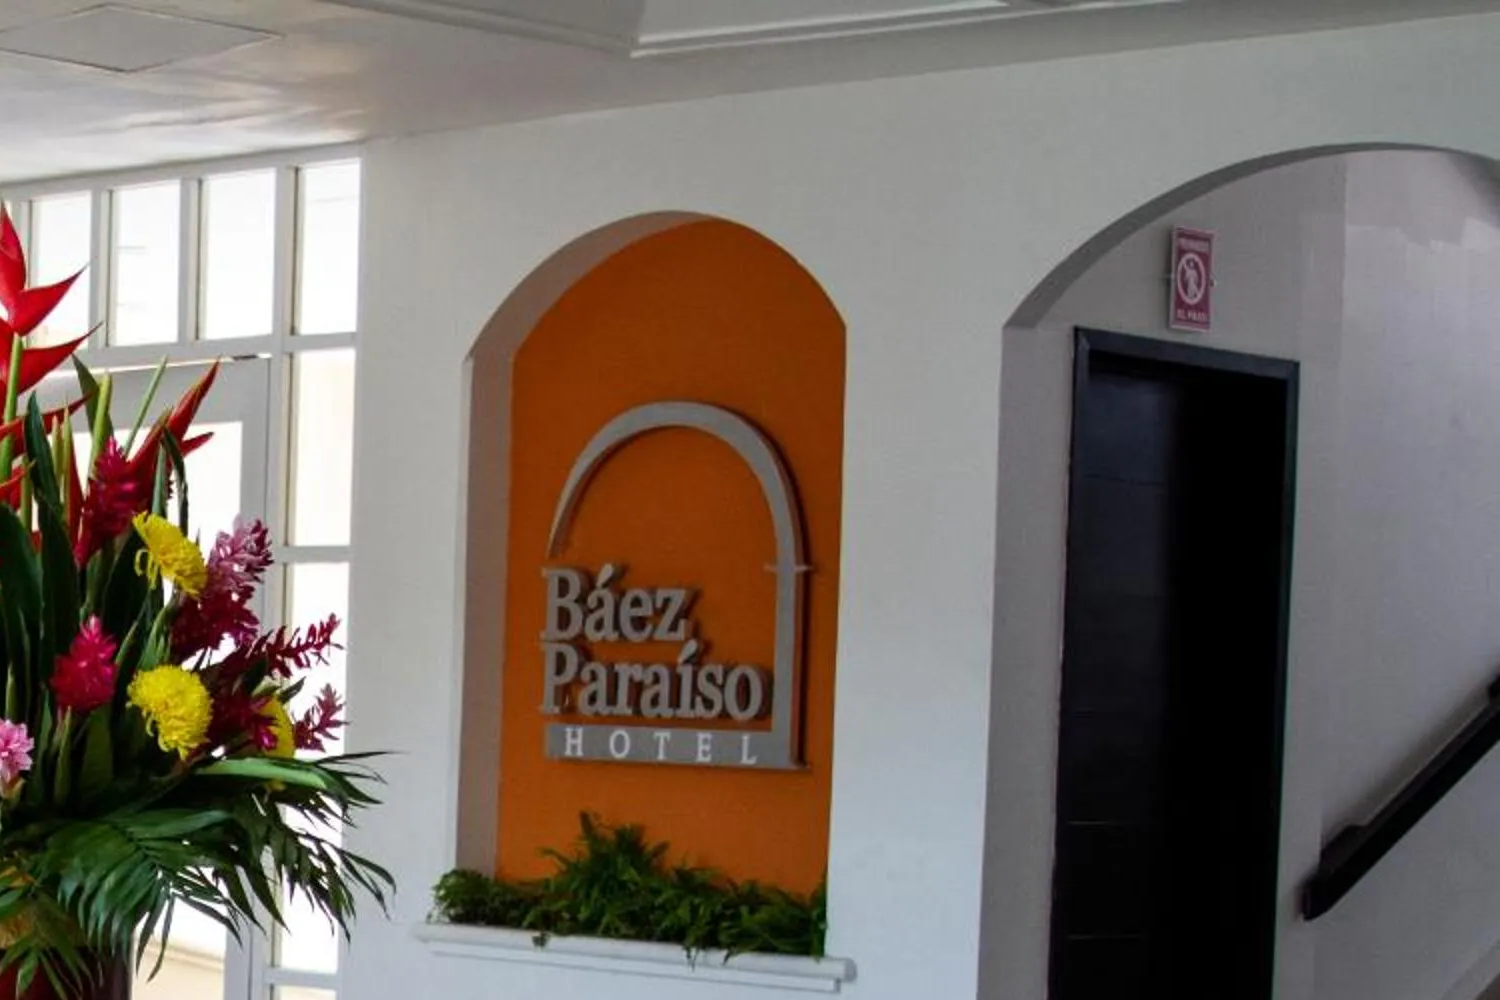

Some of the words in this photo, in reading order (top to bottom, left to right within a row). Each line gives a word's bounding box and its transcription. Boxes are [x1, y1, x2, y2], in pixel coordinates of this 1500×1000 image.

[540, 563, 688, 642] Báez
[539, 639, 764, 720] Paraíso
[563, 726, 757, 765] HOTEL
